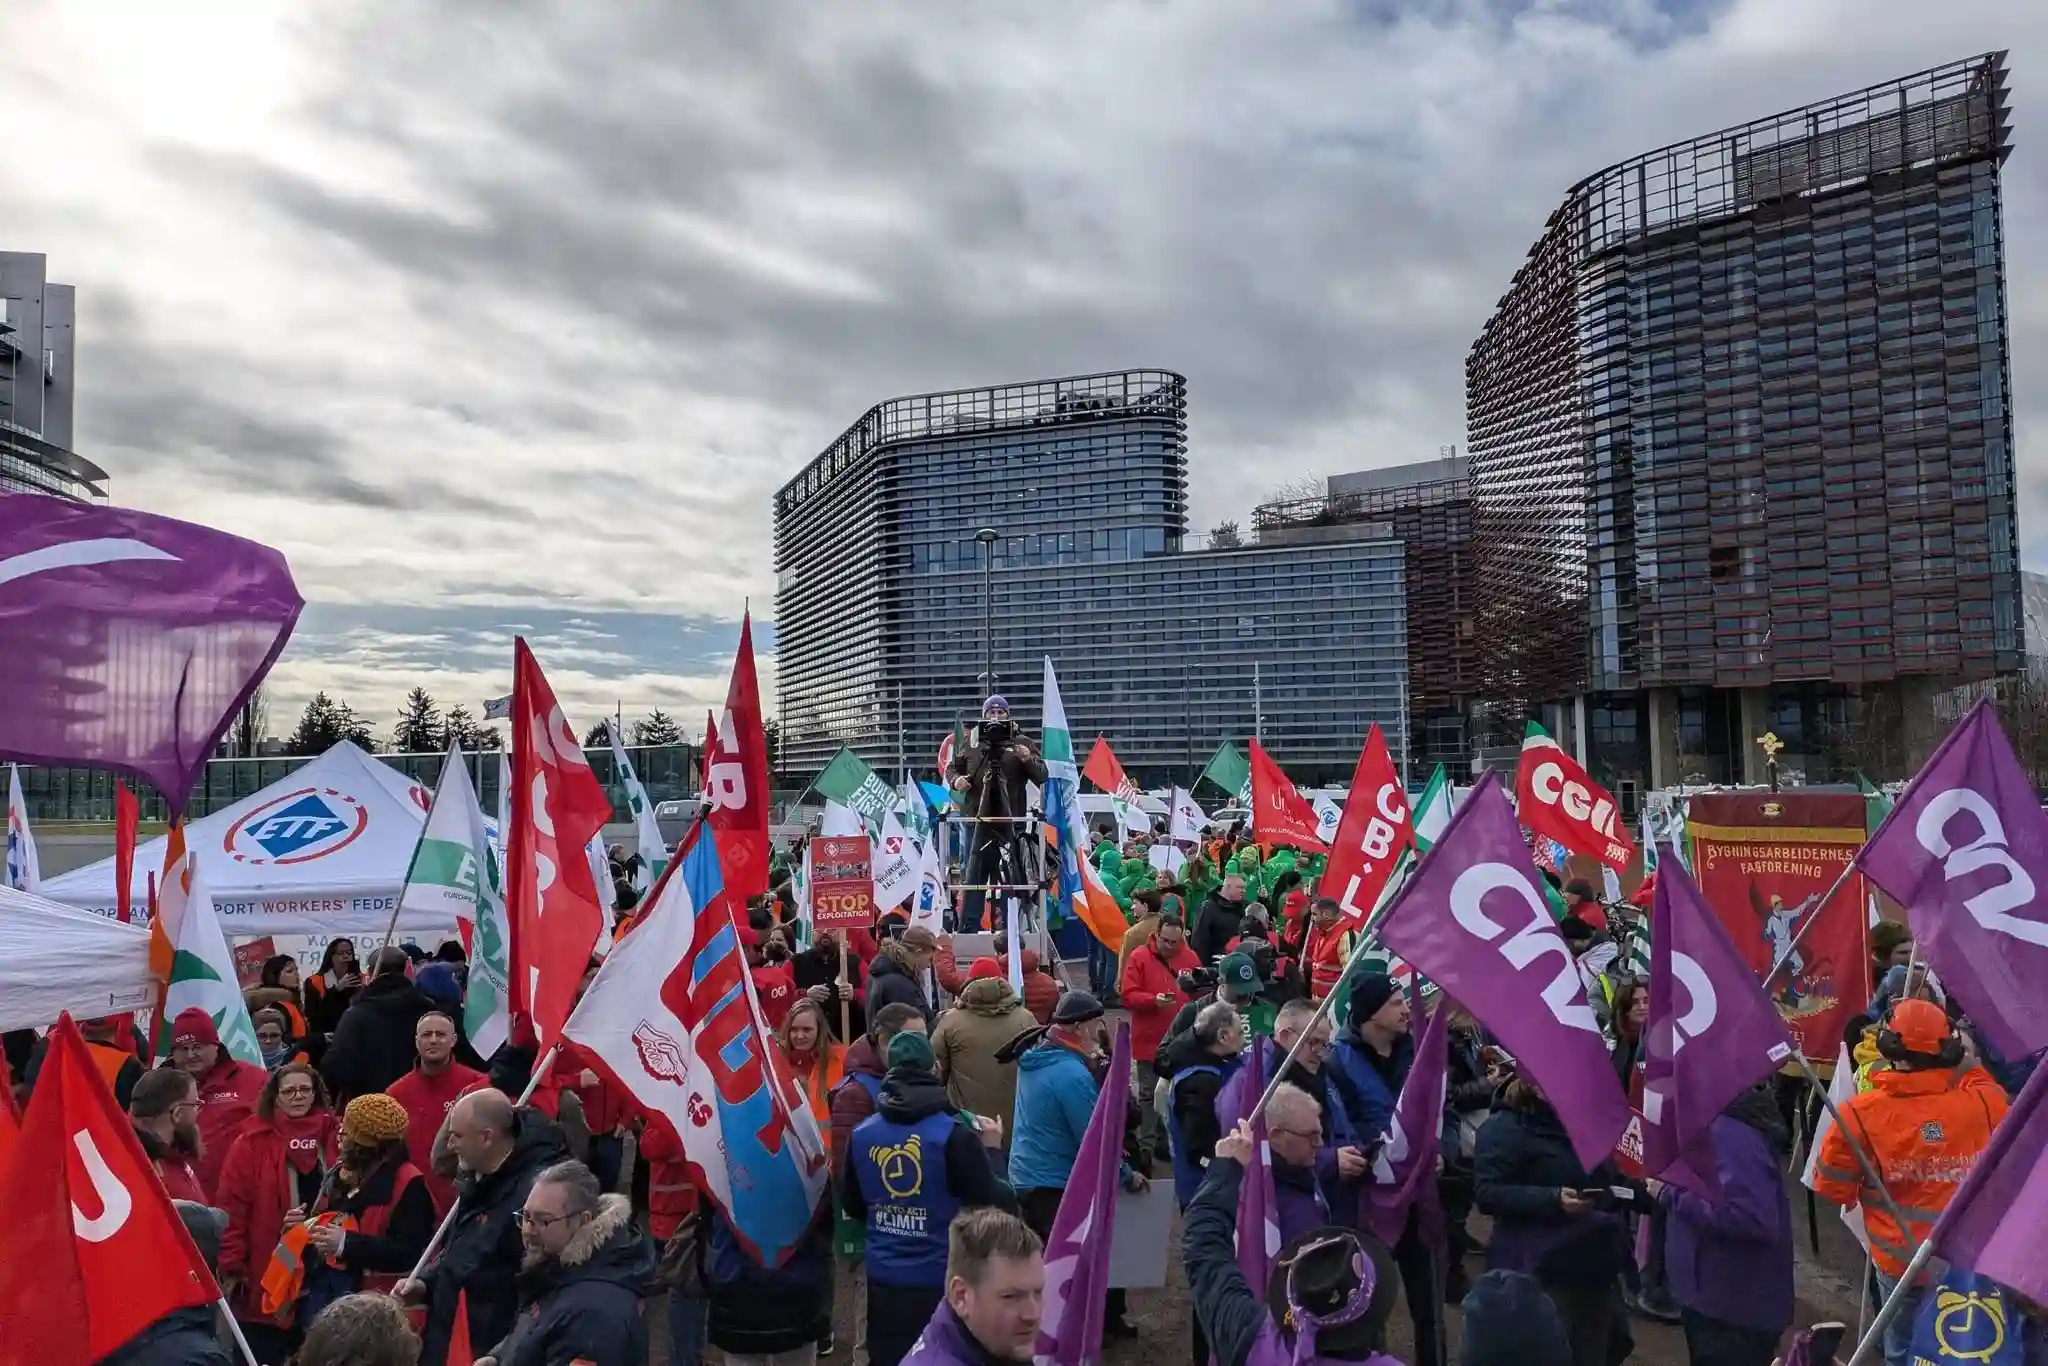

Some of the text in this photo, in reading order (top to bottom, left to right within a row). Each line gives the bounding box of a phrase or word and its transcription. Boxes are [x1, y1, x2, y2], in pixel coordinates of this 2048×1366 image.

[258, 816, 339, 842] ETF
[1706, 844, 1853, 866] BYGNINGSARBEIDERNES
[1740, 860, 1822, 878] FAGFORENING
[262, 900, 346, 913] WORKERS'
[353, 898, 398, 911] FEDE
[817, 894, 870, 912] STOP
[817, 909, 870, 921] EXPLOITATION
[876, 1211, 927, 1230] #LIMIT
